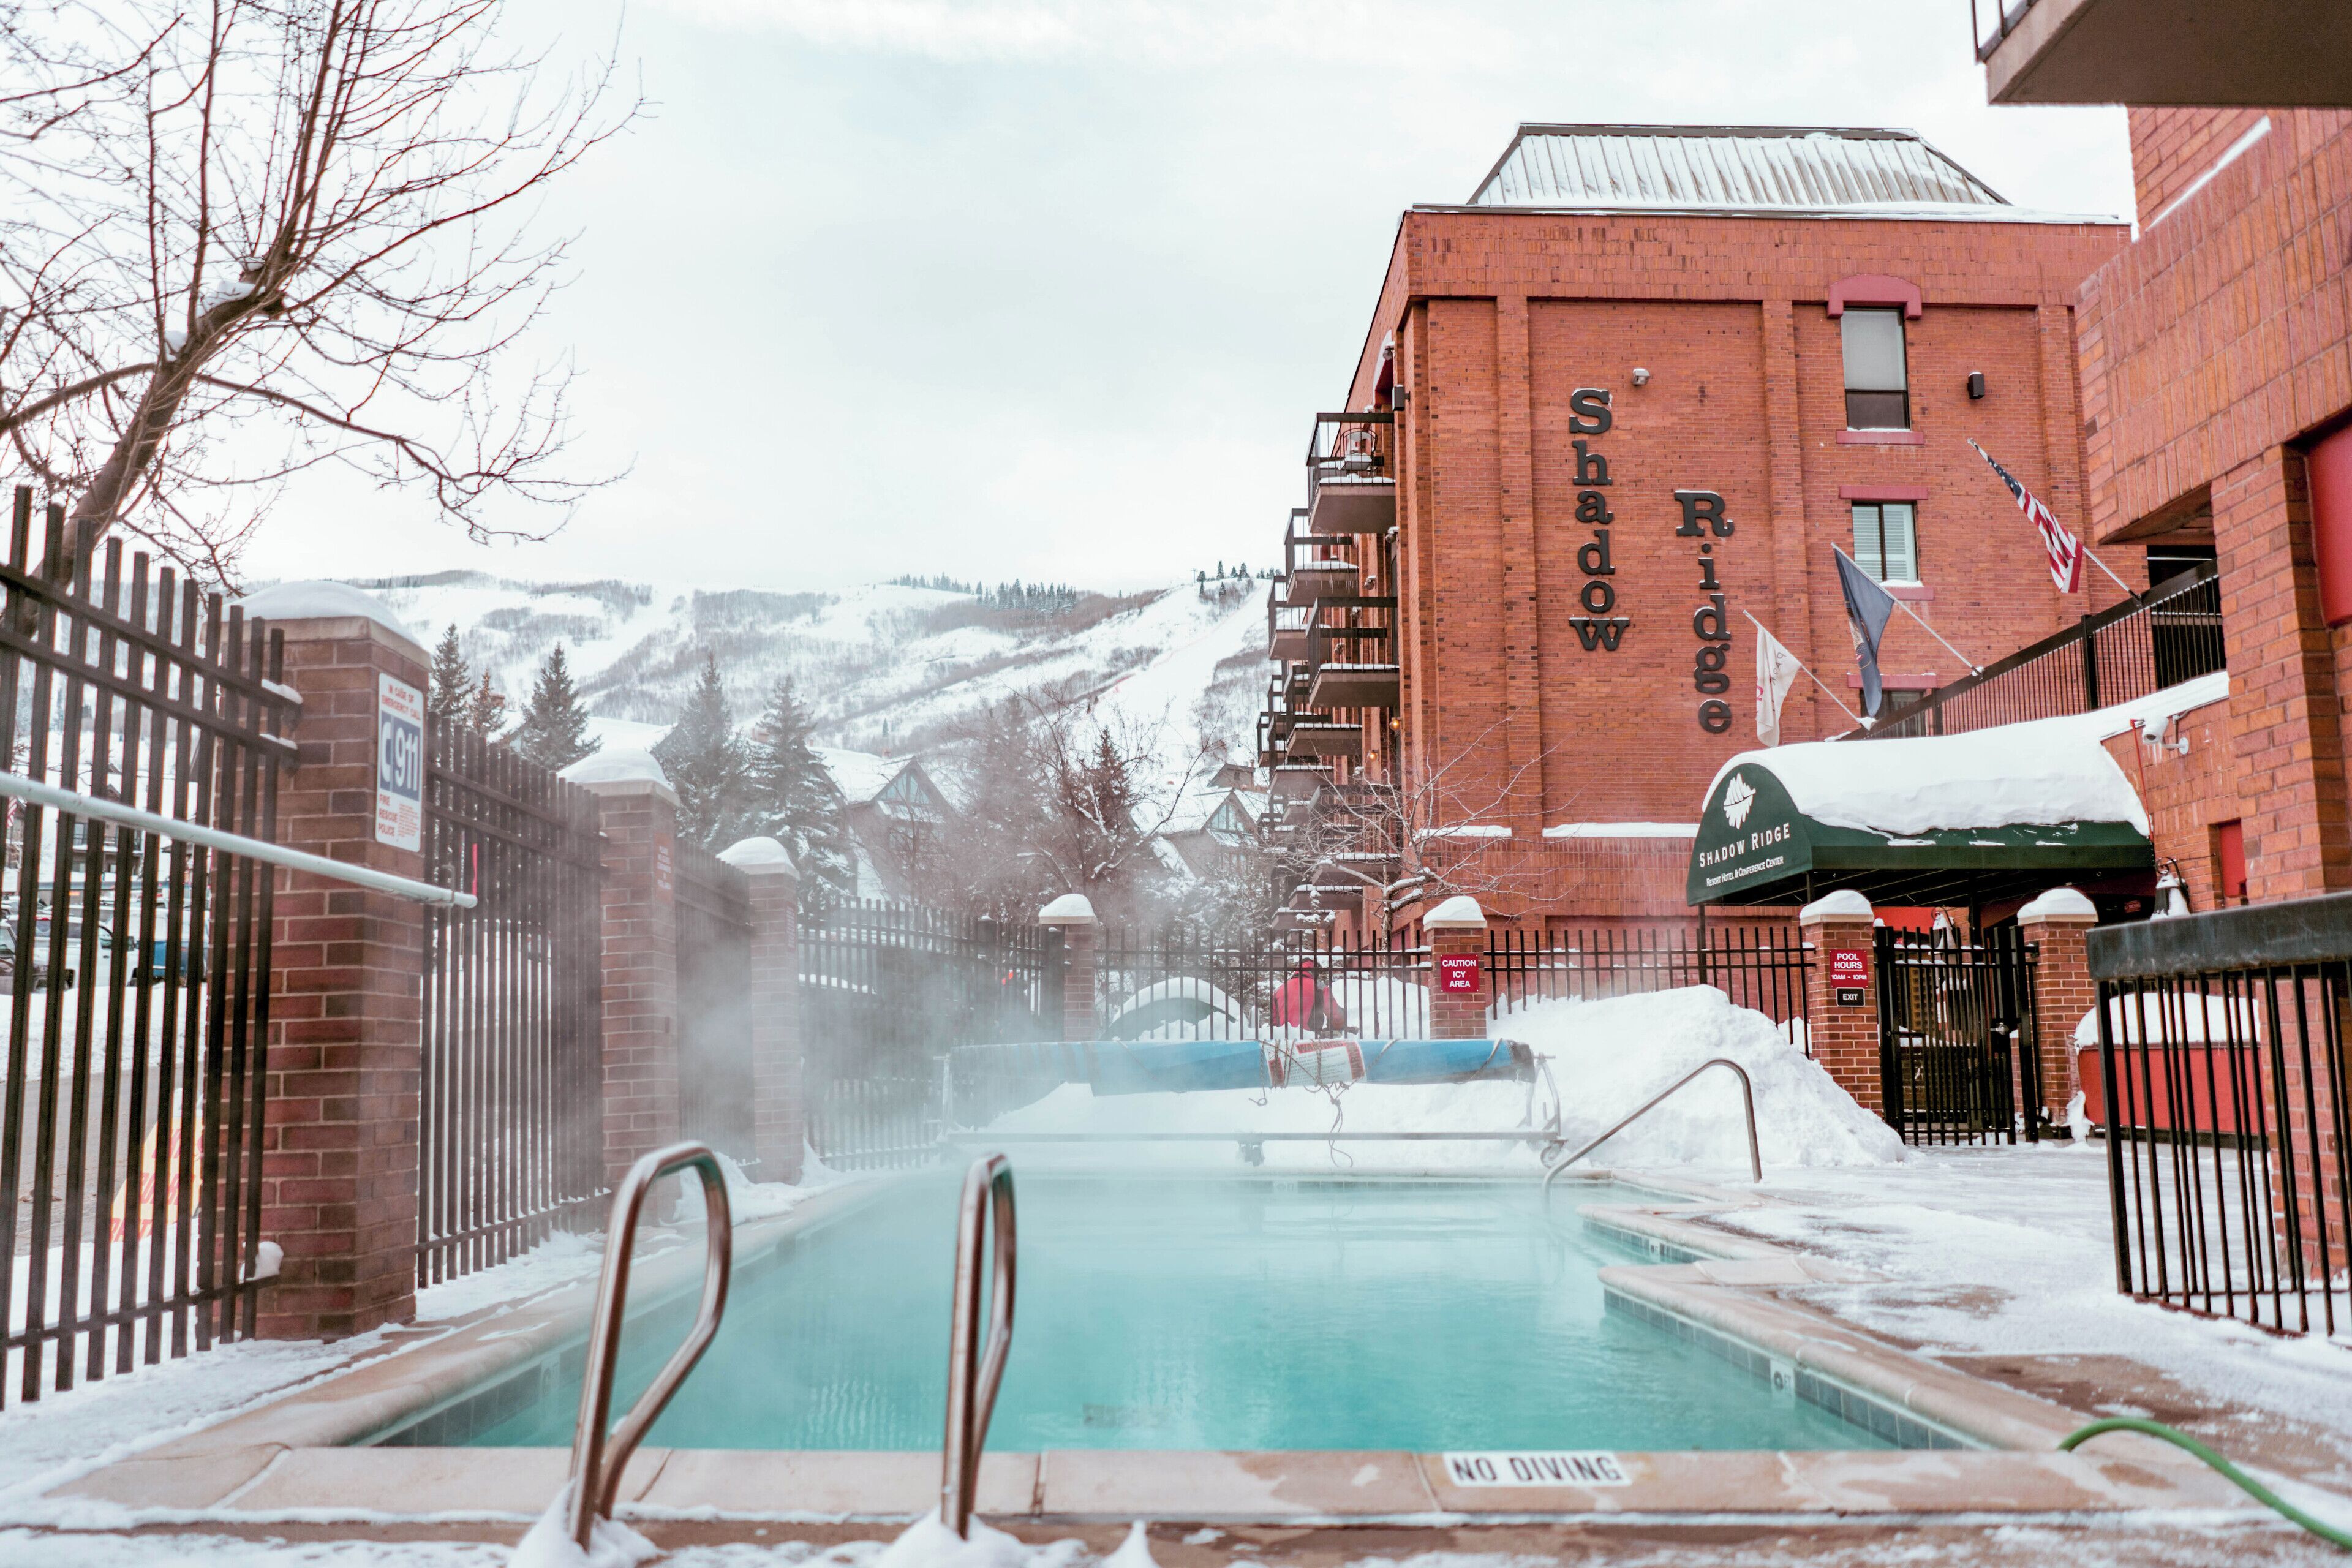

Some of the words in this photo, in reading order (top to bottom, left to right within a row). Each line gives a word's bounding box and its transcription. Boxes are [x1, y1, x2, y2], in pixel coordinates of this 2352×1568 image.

[1569, 388, 1630, 651] Shadow
[1675, 489, 1735, 734] Ridge
[394, 727, 418, 791] 911
[1699, 839, 1745, 868] SHADOW
[1751, 823, 1790, 850] RIDGE
[1735, 869, 1739, 878] &
[1738, 862, 1766, 877] CONFERENCE
[1765, 856, 1784, 869] CENTER
[1298, 1041, 1344, 1053] WANING
[1452, 1457, 1497, 1481] NO
[1509, 1457, 1623, 1481] DIVING
